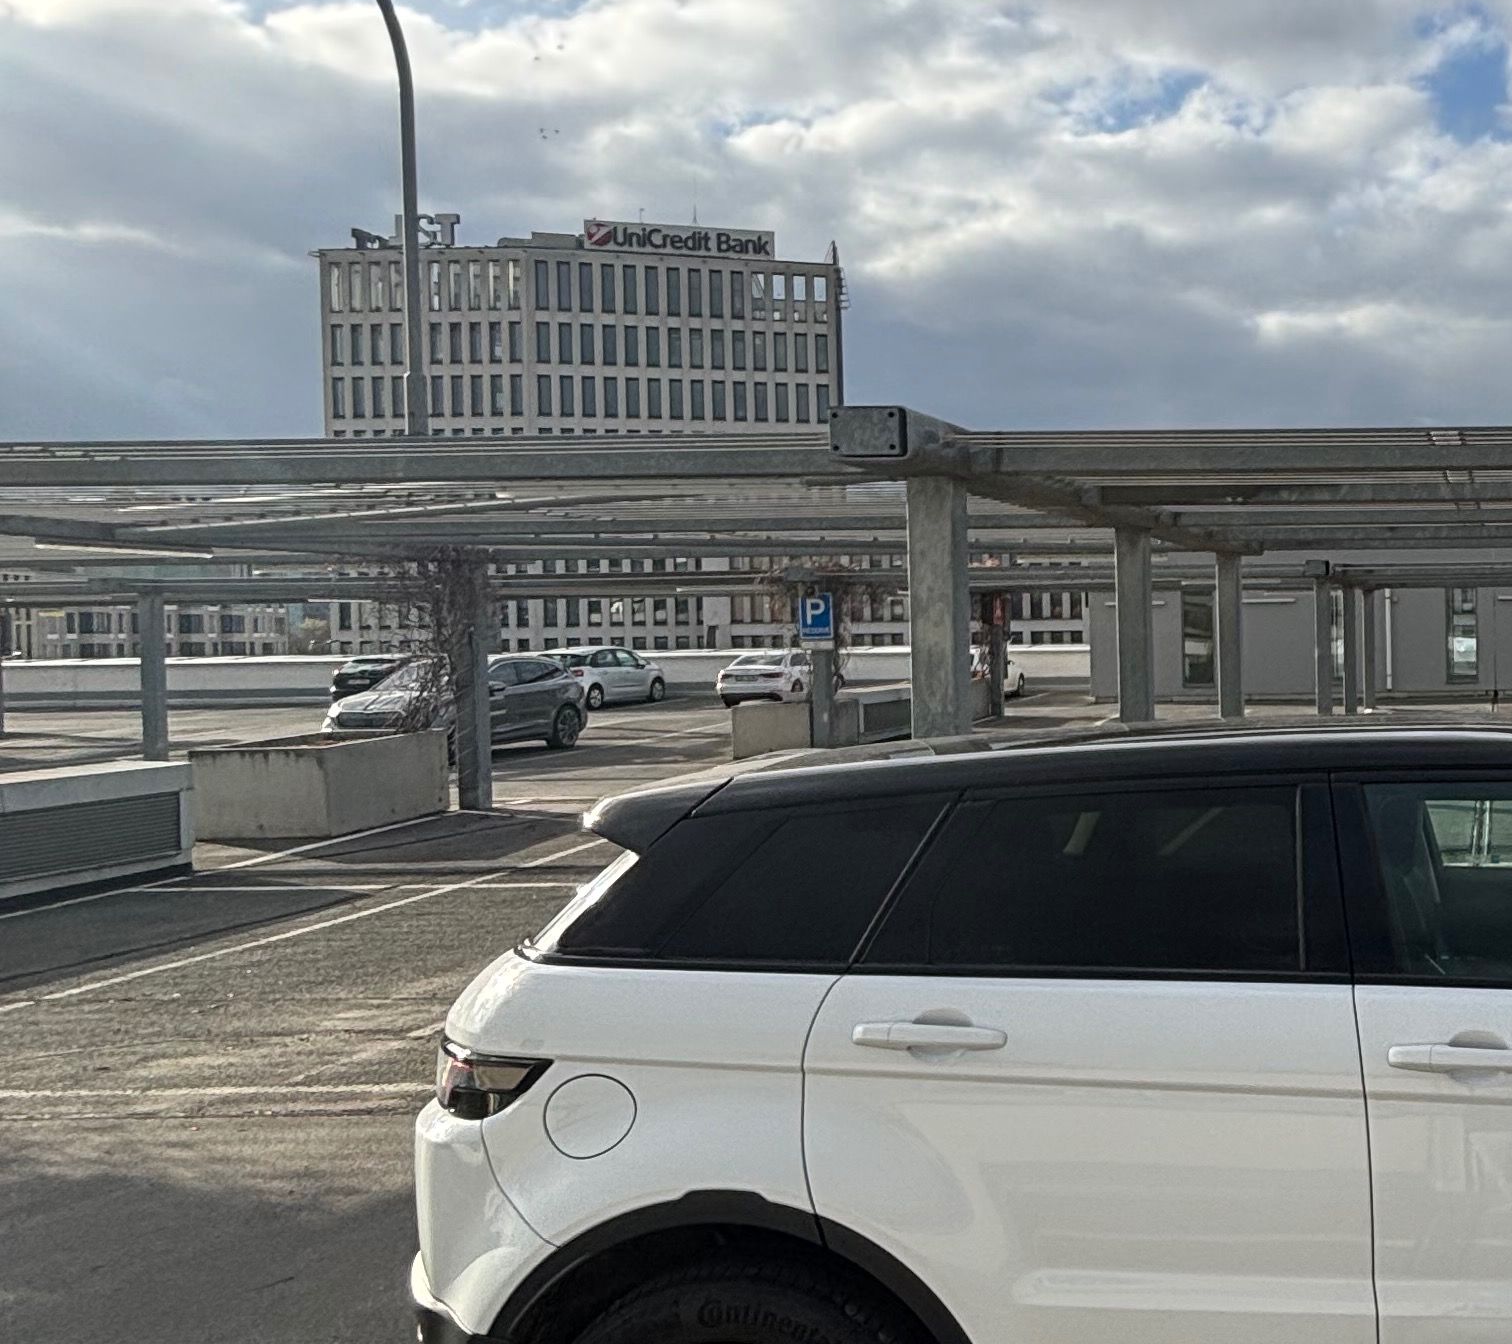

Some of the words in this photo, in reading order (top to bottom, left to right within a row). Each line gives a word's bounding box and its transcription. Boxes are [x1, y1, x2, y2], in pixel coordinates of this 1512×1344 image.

[612, 226, 711, 251] UniCredit
[716, 232, 770, 255] Bank
[806, 598, 825, 625] P
